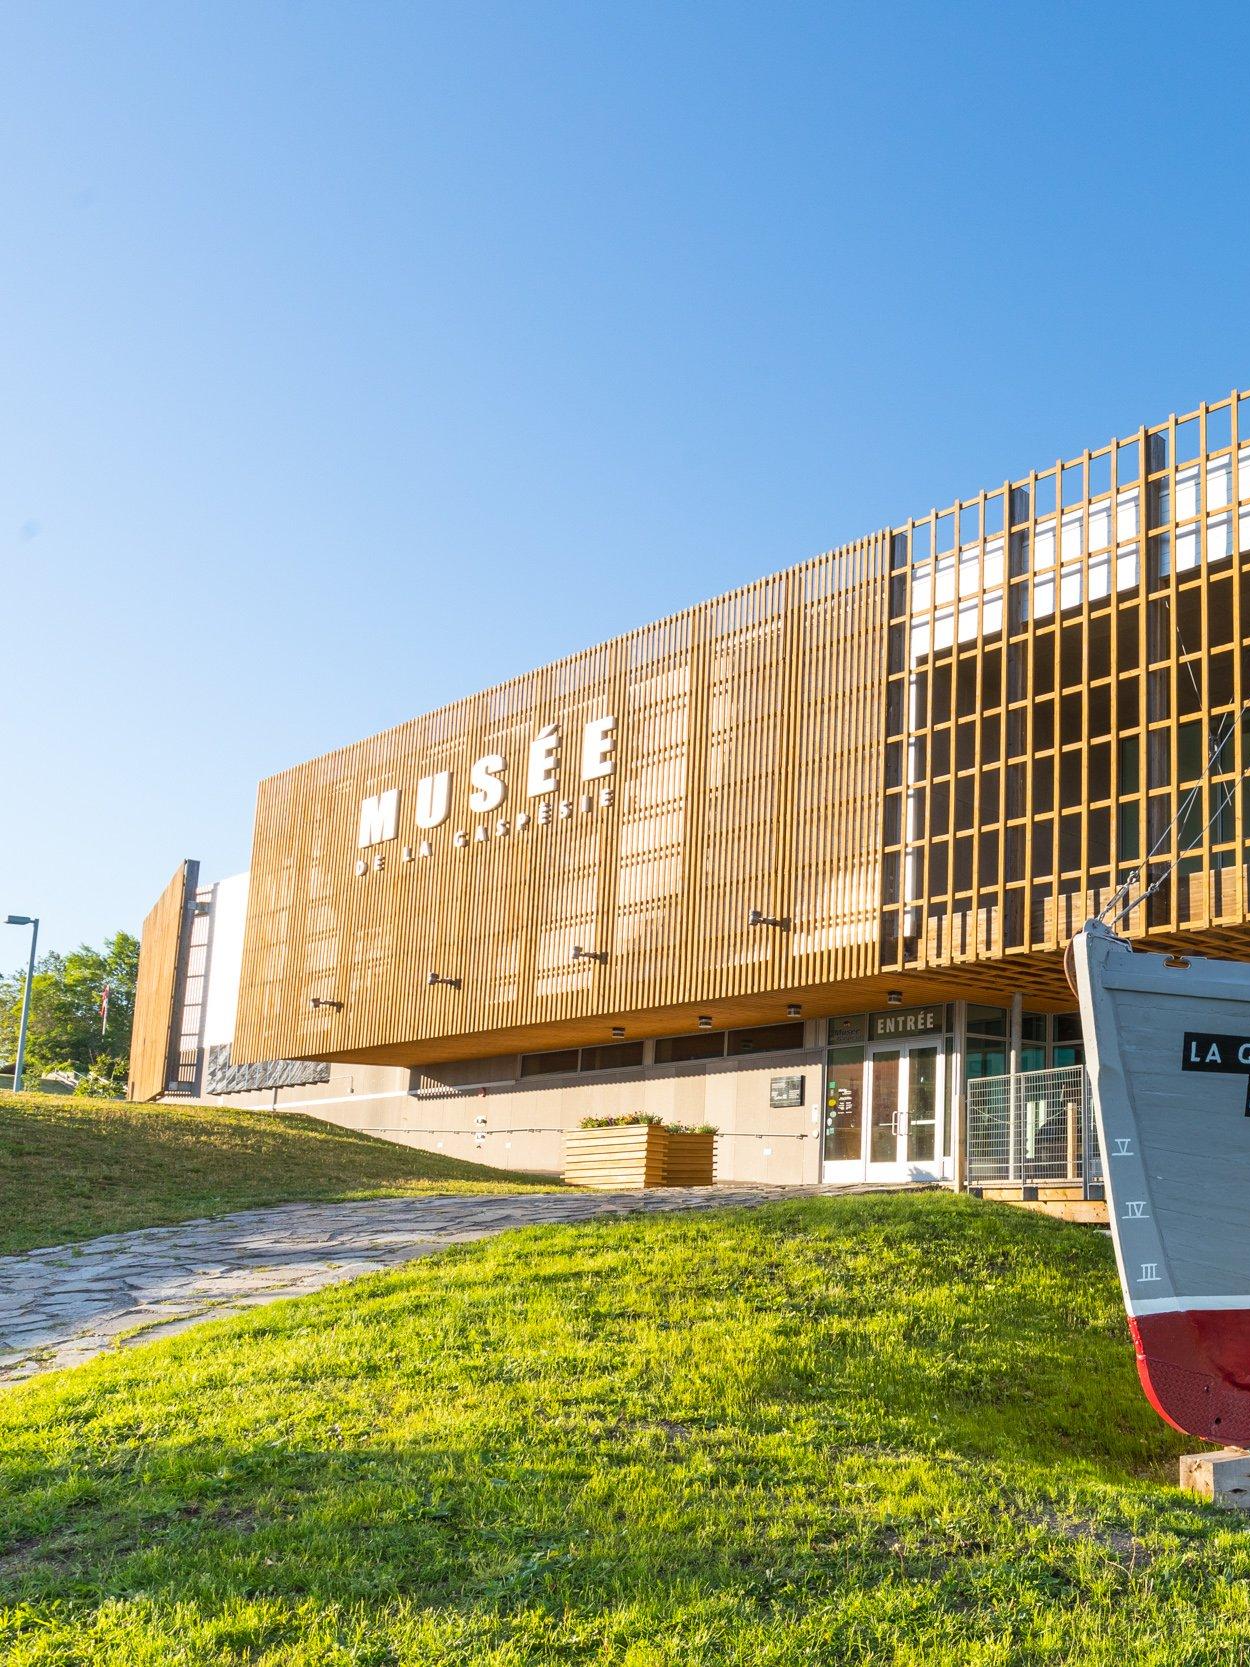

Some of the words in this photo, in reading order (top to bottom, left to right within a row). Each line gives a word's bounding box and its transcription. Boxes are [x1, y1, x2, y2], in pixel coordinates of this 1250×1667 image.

[358, 715, 618, 849] MUSÉE
[354, 854, 385, 877] DE
[403, 840, 433, 862] LA
[454, 788, 614, 848] GASPÉSIE
[877, 1011, 934, 1034] ENTRÉE
[1190, 1041, 1222, 1064] LA
[1113, 1138, 1133, 1156] V
[1124, 1201, 1148, 1218] IV
[1139, 1263, 1160, 1281] III
